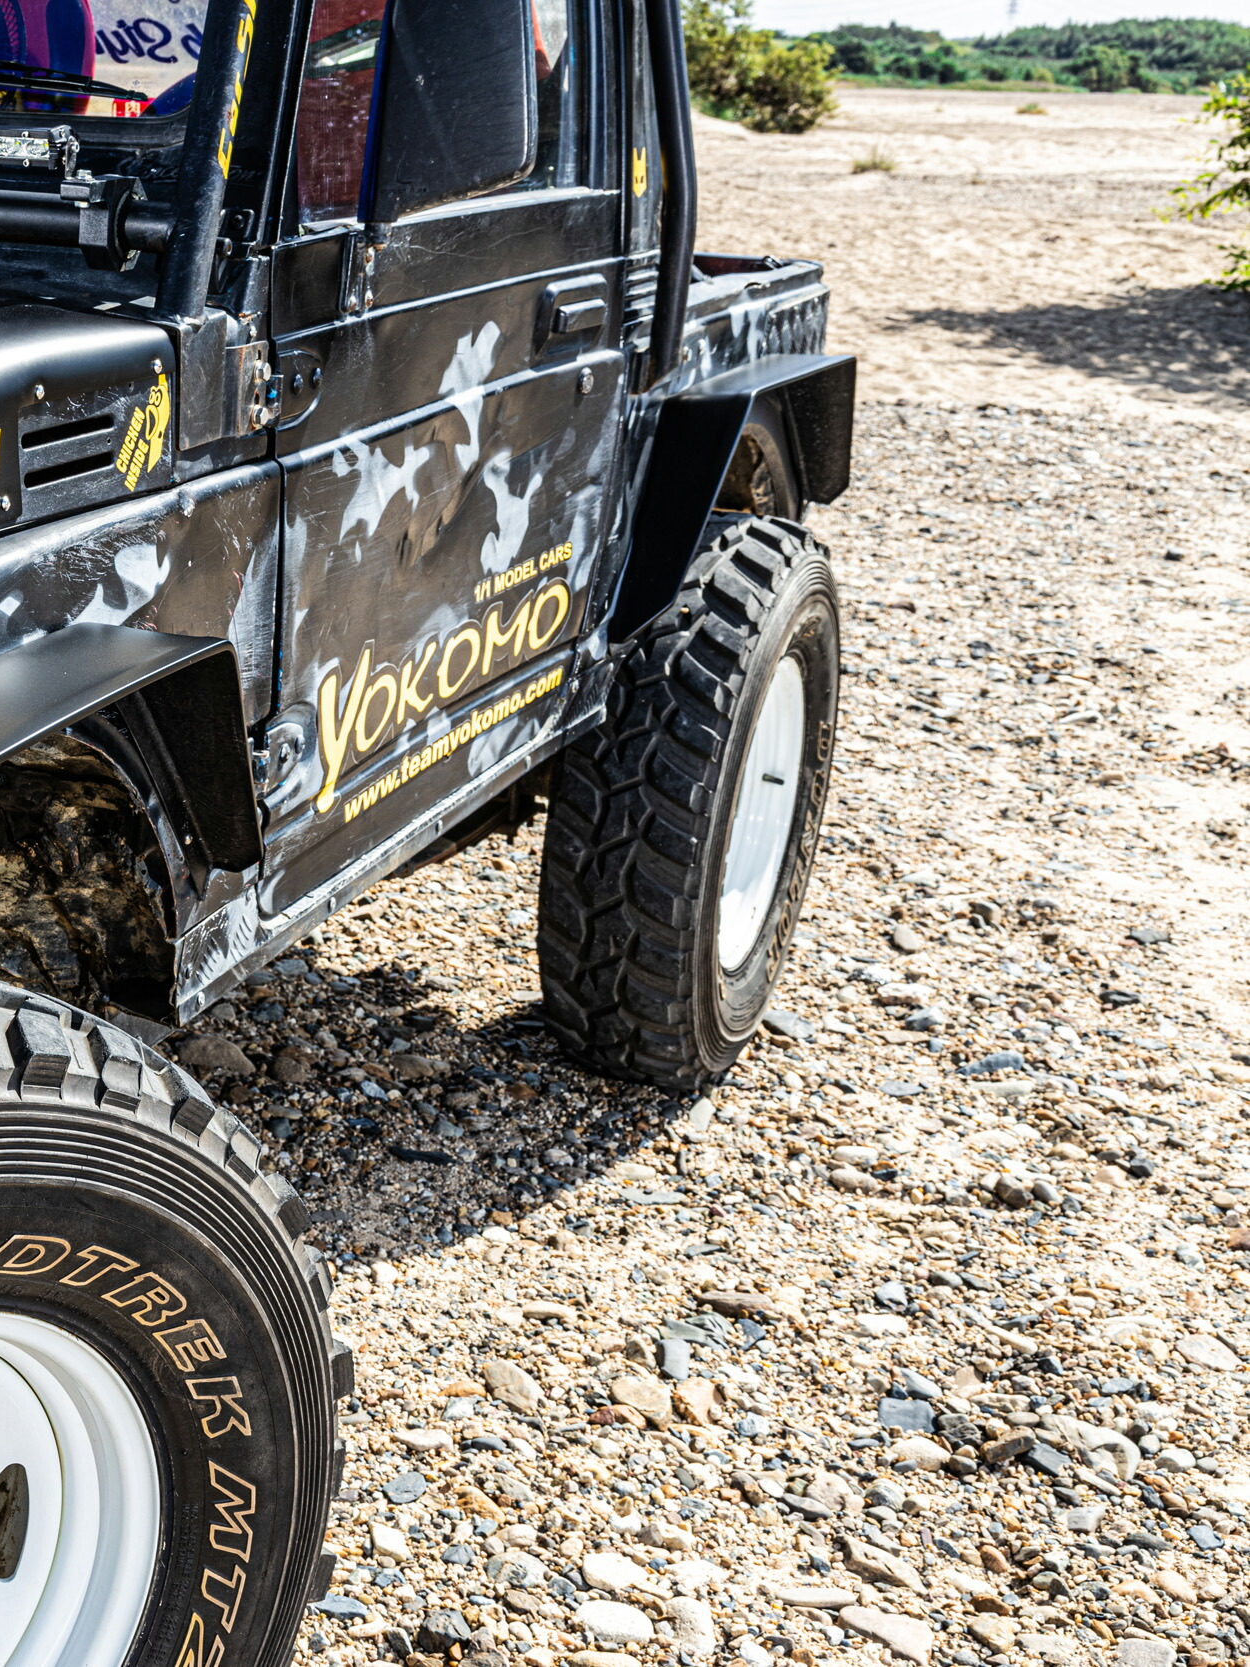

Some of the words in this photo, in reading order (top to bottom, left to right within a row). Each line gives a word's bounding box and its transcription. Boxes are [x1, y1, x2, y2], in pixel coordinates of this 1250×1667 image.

[115, 406, 145, 473] CHICKEN
[124, 439, 149, 492] INSIDE
[474, 580, 491, 603] 1/1
[494, 560, 538, 594] MODEL
[539, 541, 572, 571] CARS
[316, 584, 569, 813] YOKOMO
[344, 667, 563, 823] www.teamyokomo.com
[765, 720, 832, 984] DUNLOP
